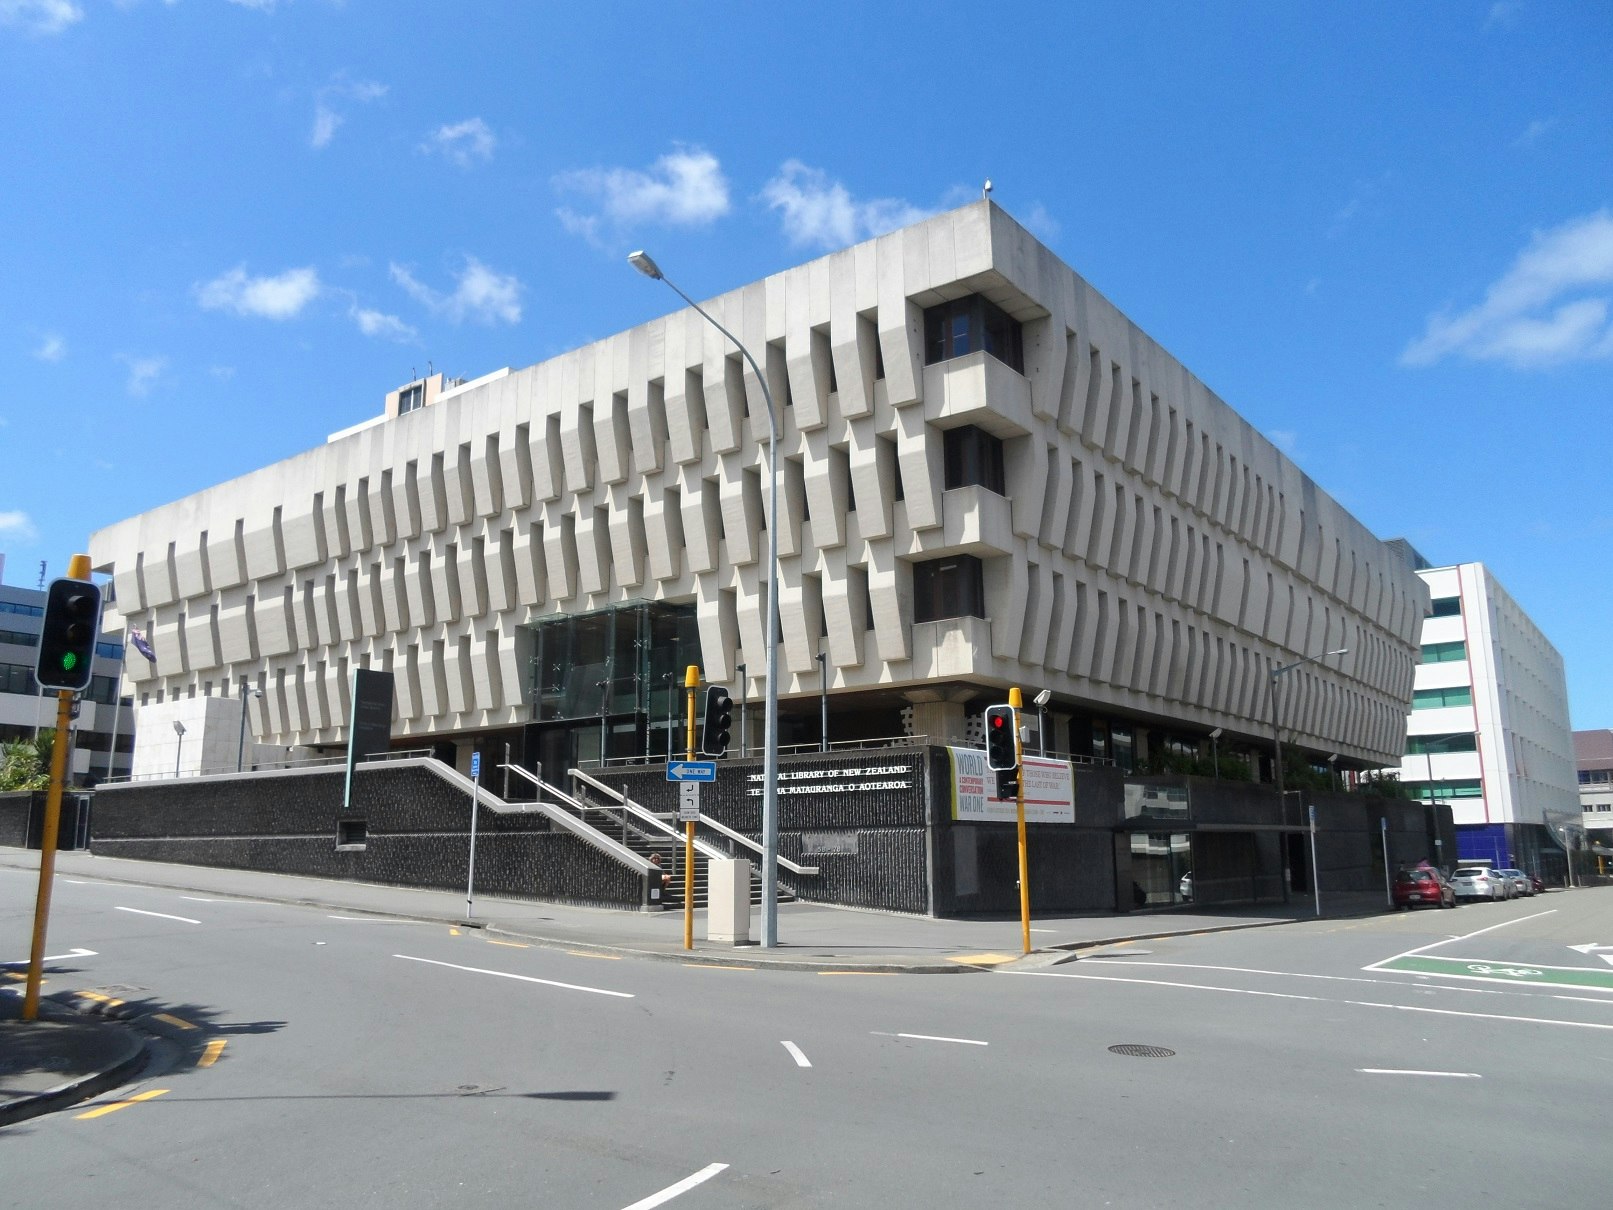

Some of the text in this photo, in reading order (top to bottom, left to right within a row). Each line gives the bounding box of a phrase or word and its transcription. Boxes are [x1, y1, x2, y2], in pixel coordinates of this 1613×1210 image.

[956, 753, 984, 775] WORLD
[750, 766, 907, 781] NATAL LIBRARY OF NEW ZEALAND
[751, 788, 761, 796] TE
[789, 784, 844, 794] MATAURANGA
[848, 783, 855, 791] O
[859, 781, 907, 790] AOTEAROA
[960, 796, 971, 812] WAR
[972, 796, 984, 813] ONE
